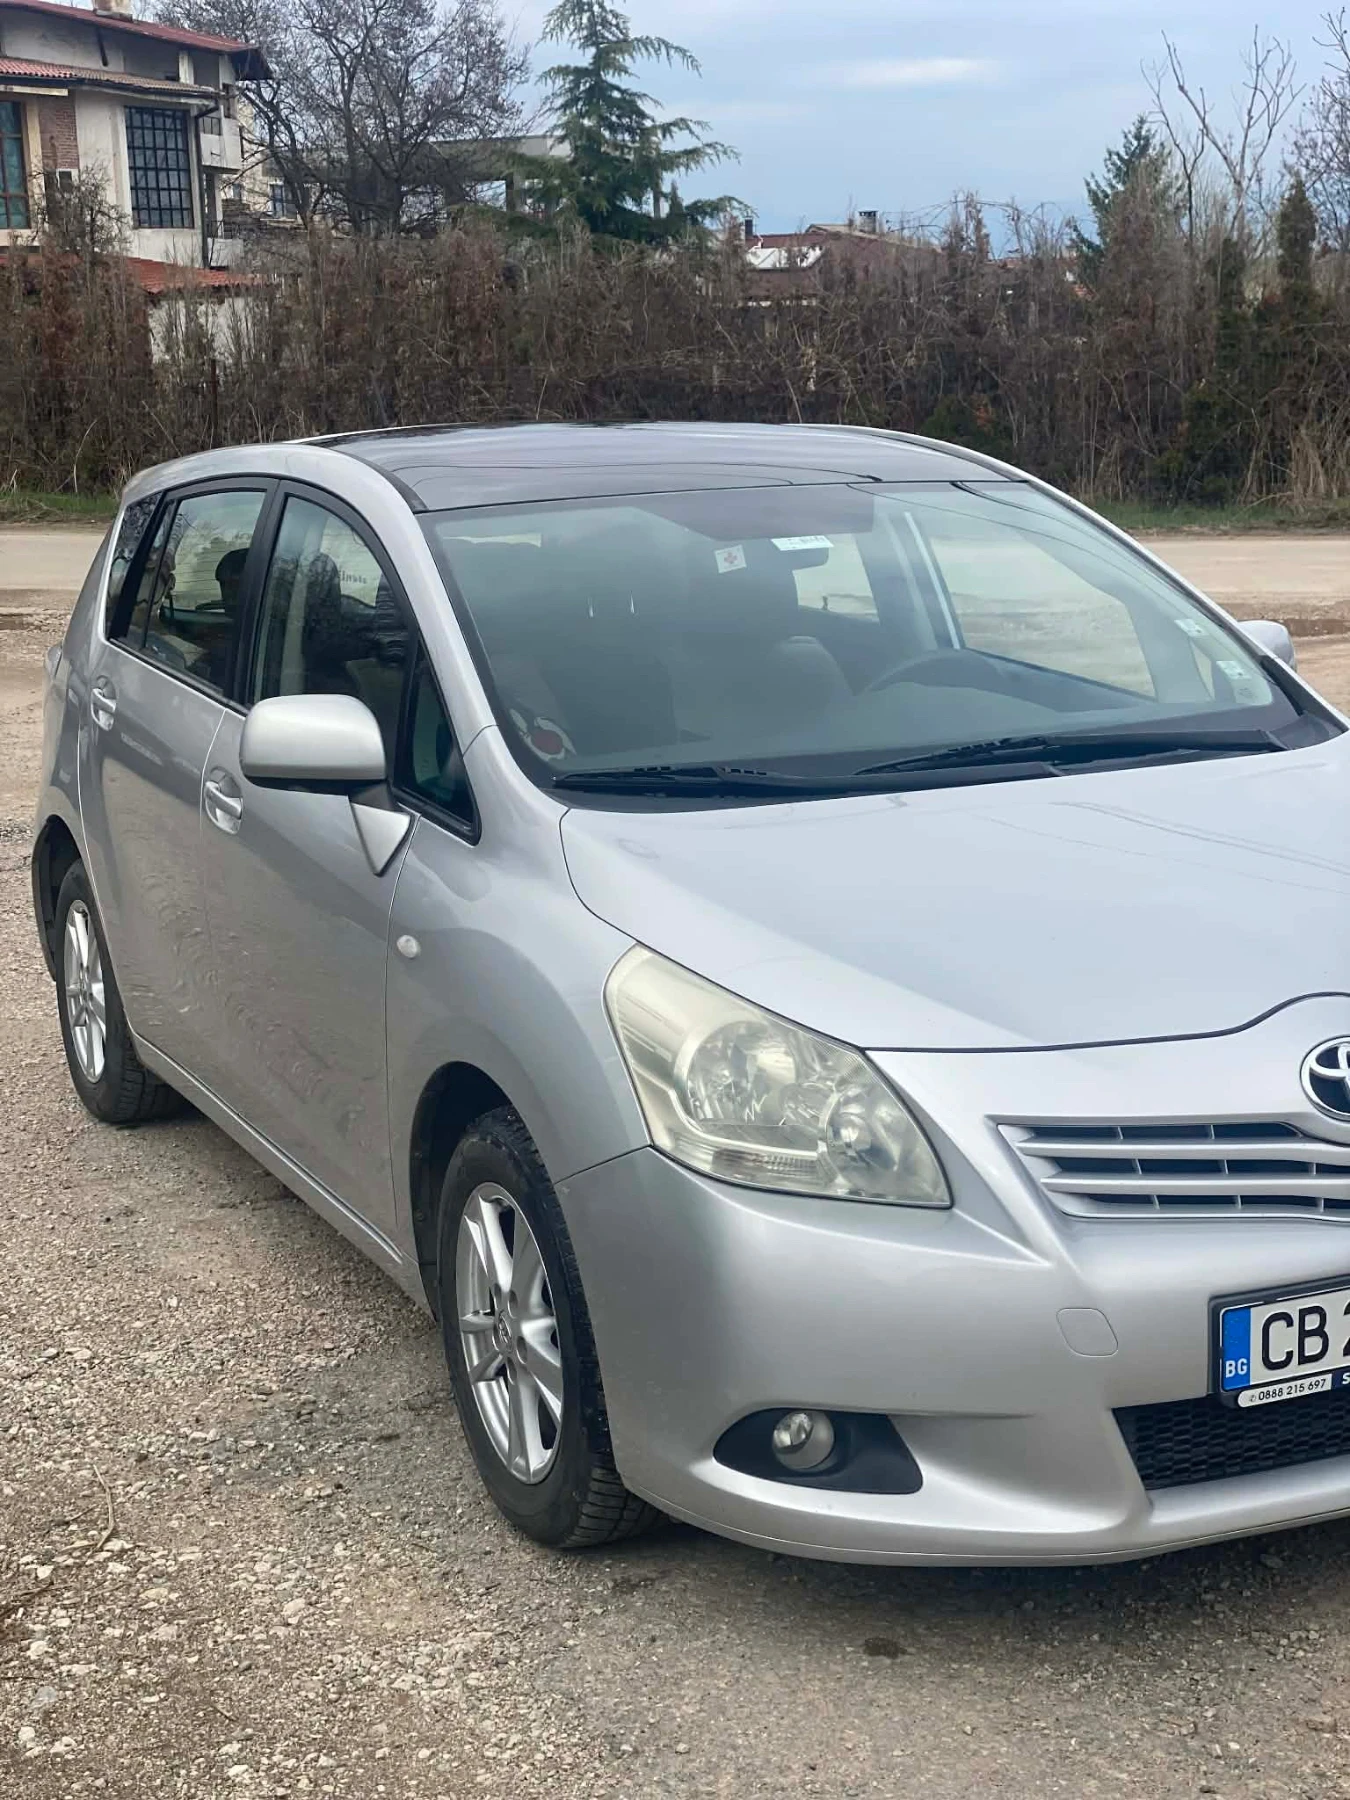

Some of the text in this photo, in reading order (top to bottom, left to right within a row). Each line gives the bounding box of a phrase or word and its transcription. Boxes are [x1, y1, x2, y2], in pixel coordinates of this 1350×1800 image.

[1261, 1305, 1330, 1371] CB
[1225, 1358, 1248, 1378] BG
[1258, 1378, 1326, 1401] 0888 215 697
